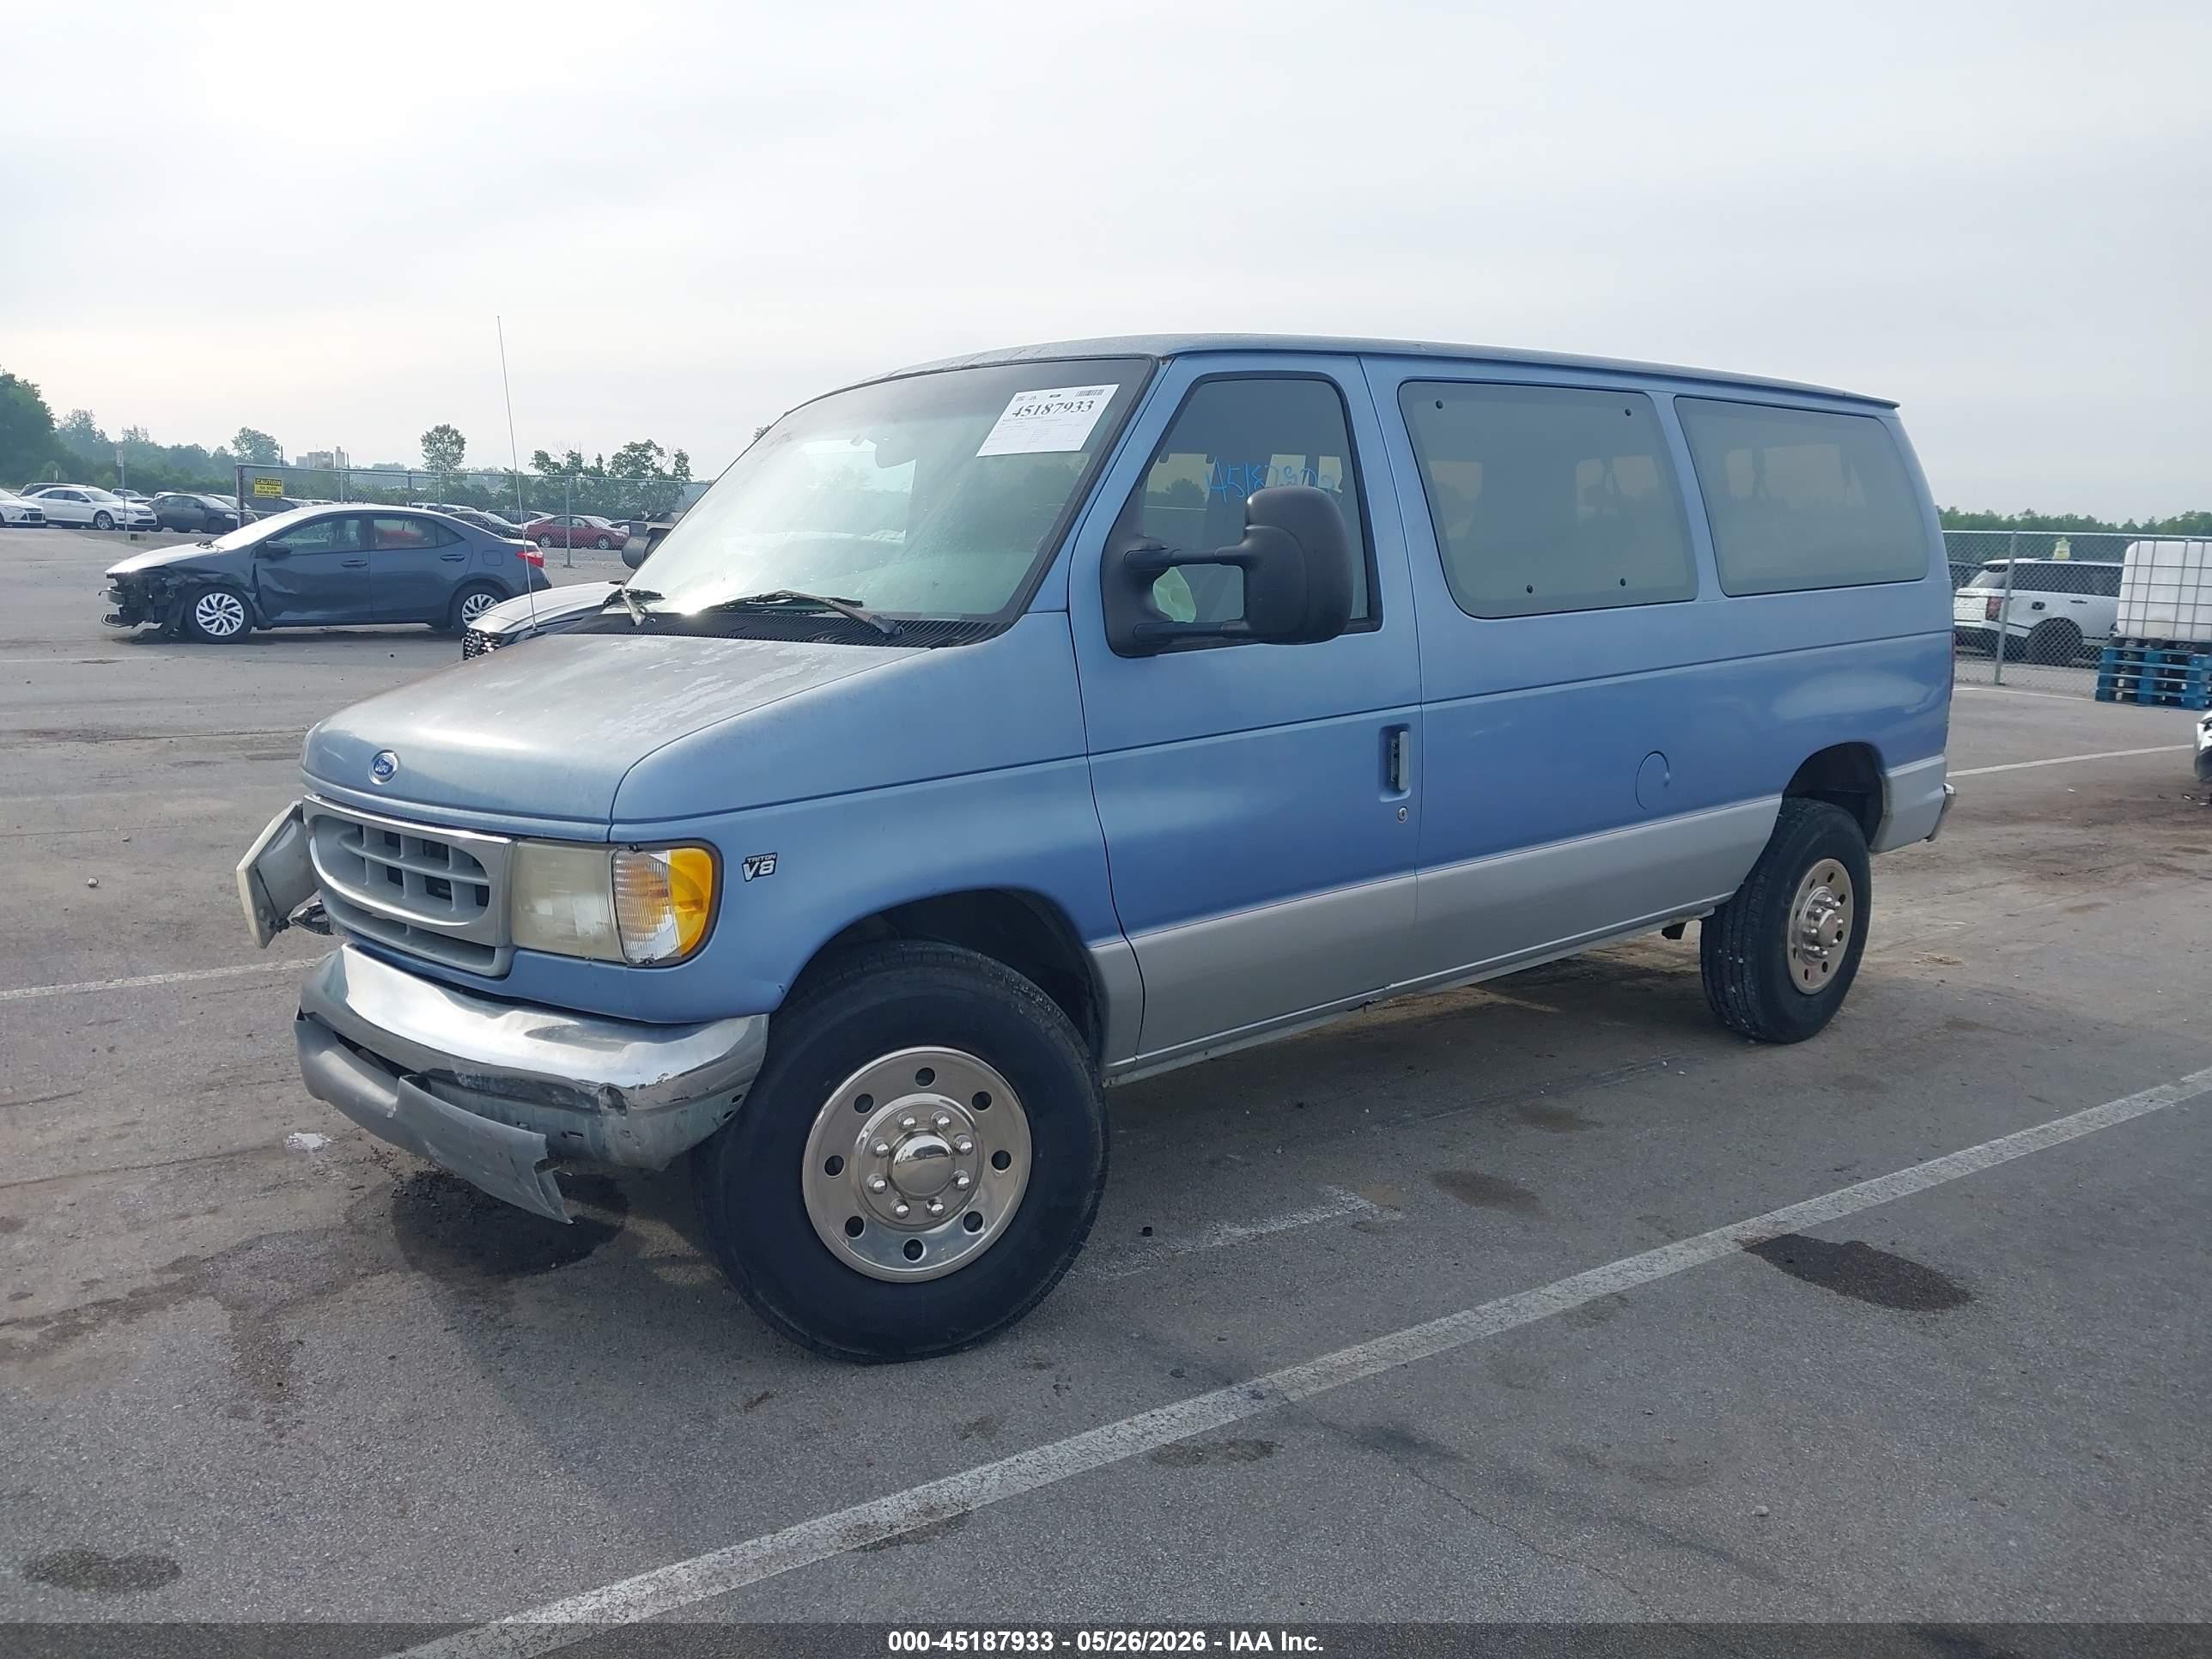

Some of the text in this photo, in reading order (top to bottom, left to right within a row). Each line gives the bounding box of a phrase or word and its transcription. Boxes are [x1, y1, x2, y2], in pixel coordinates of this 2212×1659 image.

[1012, 399, 1096, 417] 45187933
[746, 853, 777, 863] TRITON
[742, 860, 775, 881] V8
